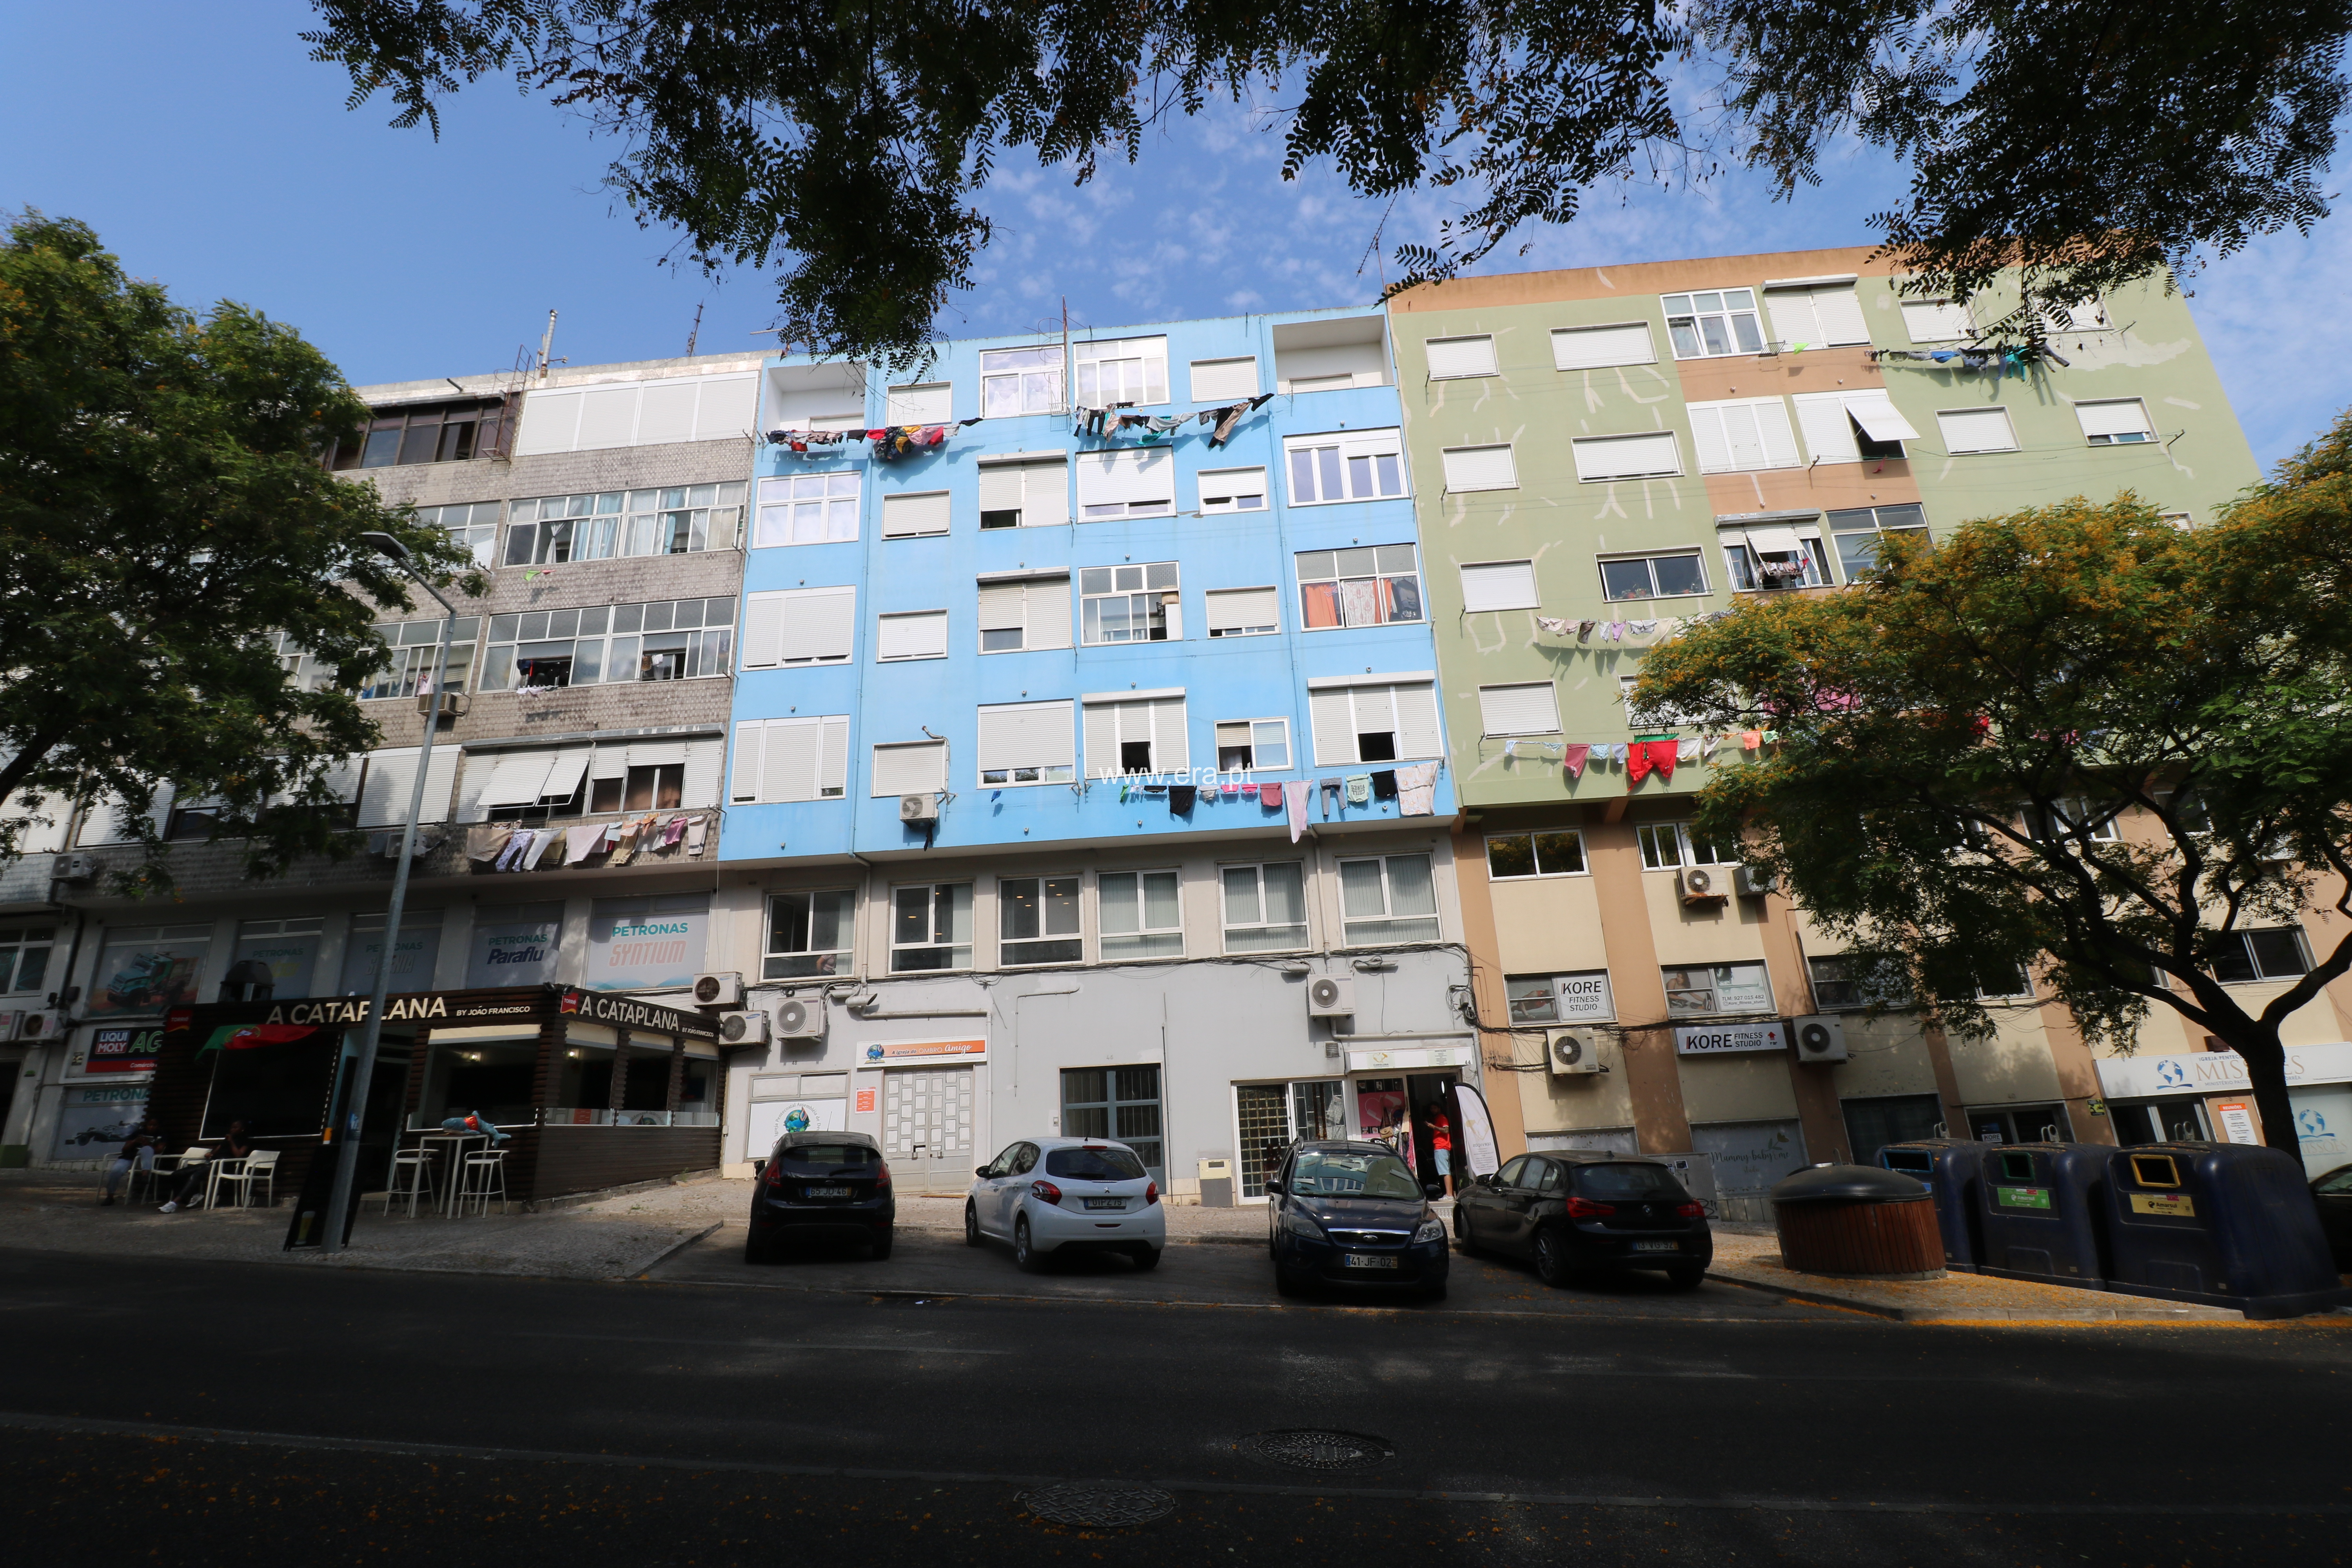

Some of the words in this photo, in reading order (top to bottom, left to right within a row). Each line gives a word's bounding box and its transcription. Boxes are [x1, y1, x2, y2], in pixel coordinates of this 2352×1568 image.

[612, 923, 688, 937] PETRONAS
[366, 942, 423, 952] PEONAS
[488, 934, 547, 946] PETRONAS
[253, 947, 304, 957] PETRONAS
[487, 946, 545, 964] Paraflu
[609, 940, 686, 967] SYNTIUM
[1561, 981, 1602, 995] KORE
[266, 1005, 284, 1024] A
[290, 997, 447, 1024] CATAPANA
[468, 1006, 487, 1015] JOÃO
[488, 1006, 530, 1014] FRANCISCO
[580, 996, 592, 1016] A
[597, 998, 679, 1031] CATAPLANA
[100, 1032, 129, 1042] LIQUI
[688, 1027, 696, 1035] JOÃO
[696, 1029, 713, 1037] FRANCISCO
[97, 1042, 127, 1053] MOLY
[1686, 1034, 1732, 1049] KORE
[775, 1103, 796, 1122] Pentecostal
